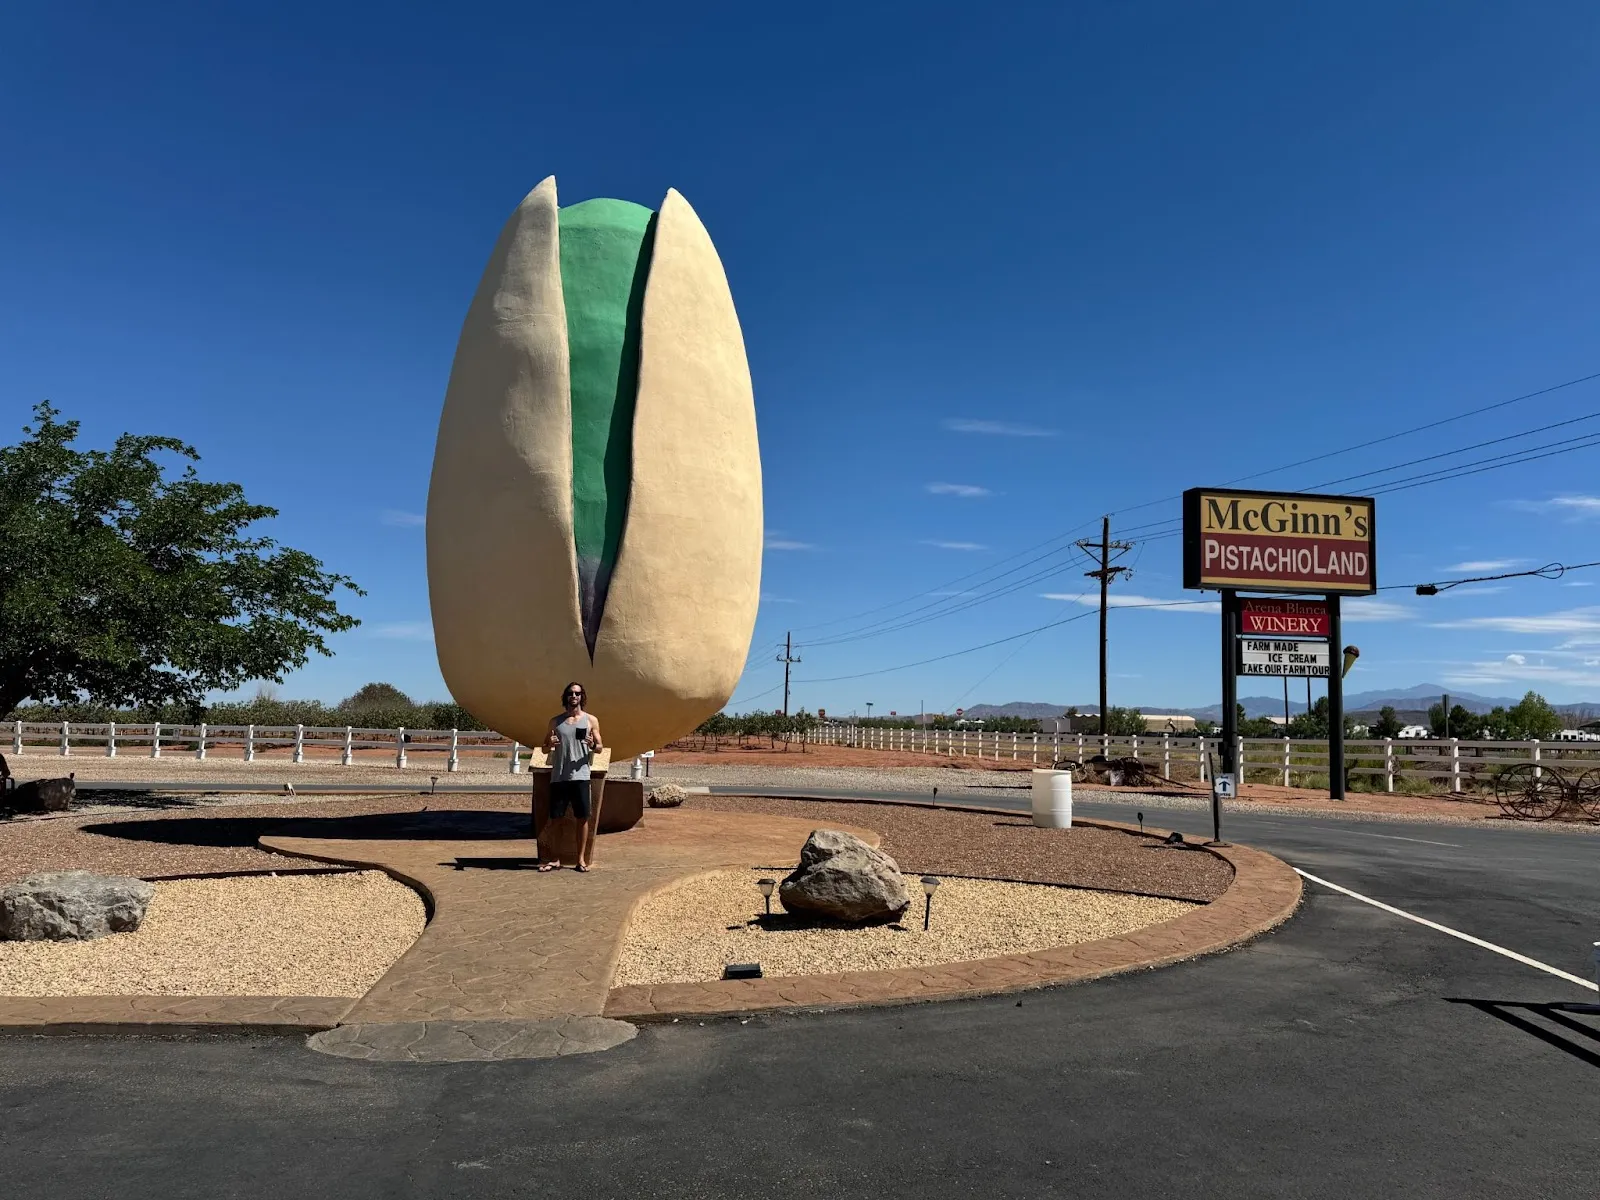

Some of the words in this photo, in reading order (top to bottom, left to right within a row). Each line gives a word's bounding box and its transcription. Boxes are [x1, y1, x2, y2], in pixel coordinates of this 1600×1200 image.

[1205, 498, 1368, 538] McGinn's
[1204, 539, 1368, 576] PISTACHIOLAND
[1245, 600, 1281, 613] Arena
[1285, 602, 1326, 615] Blanca
[1250, 615, 1322, 632] WINERY
[1247, 641, 1271, 651] FARM
[1274, 642, 1299, 652] MADE
[1268, 653, 1283, 663] ICE
[1288, 654, 1317, 664] CREAM
[1243, 664, 1263, 674] TAKE
[1264, 664, 1282, 674] OUR
